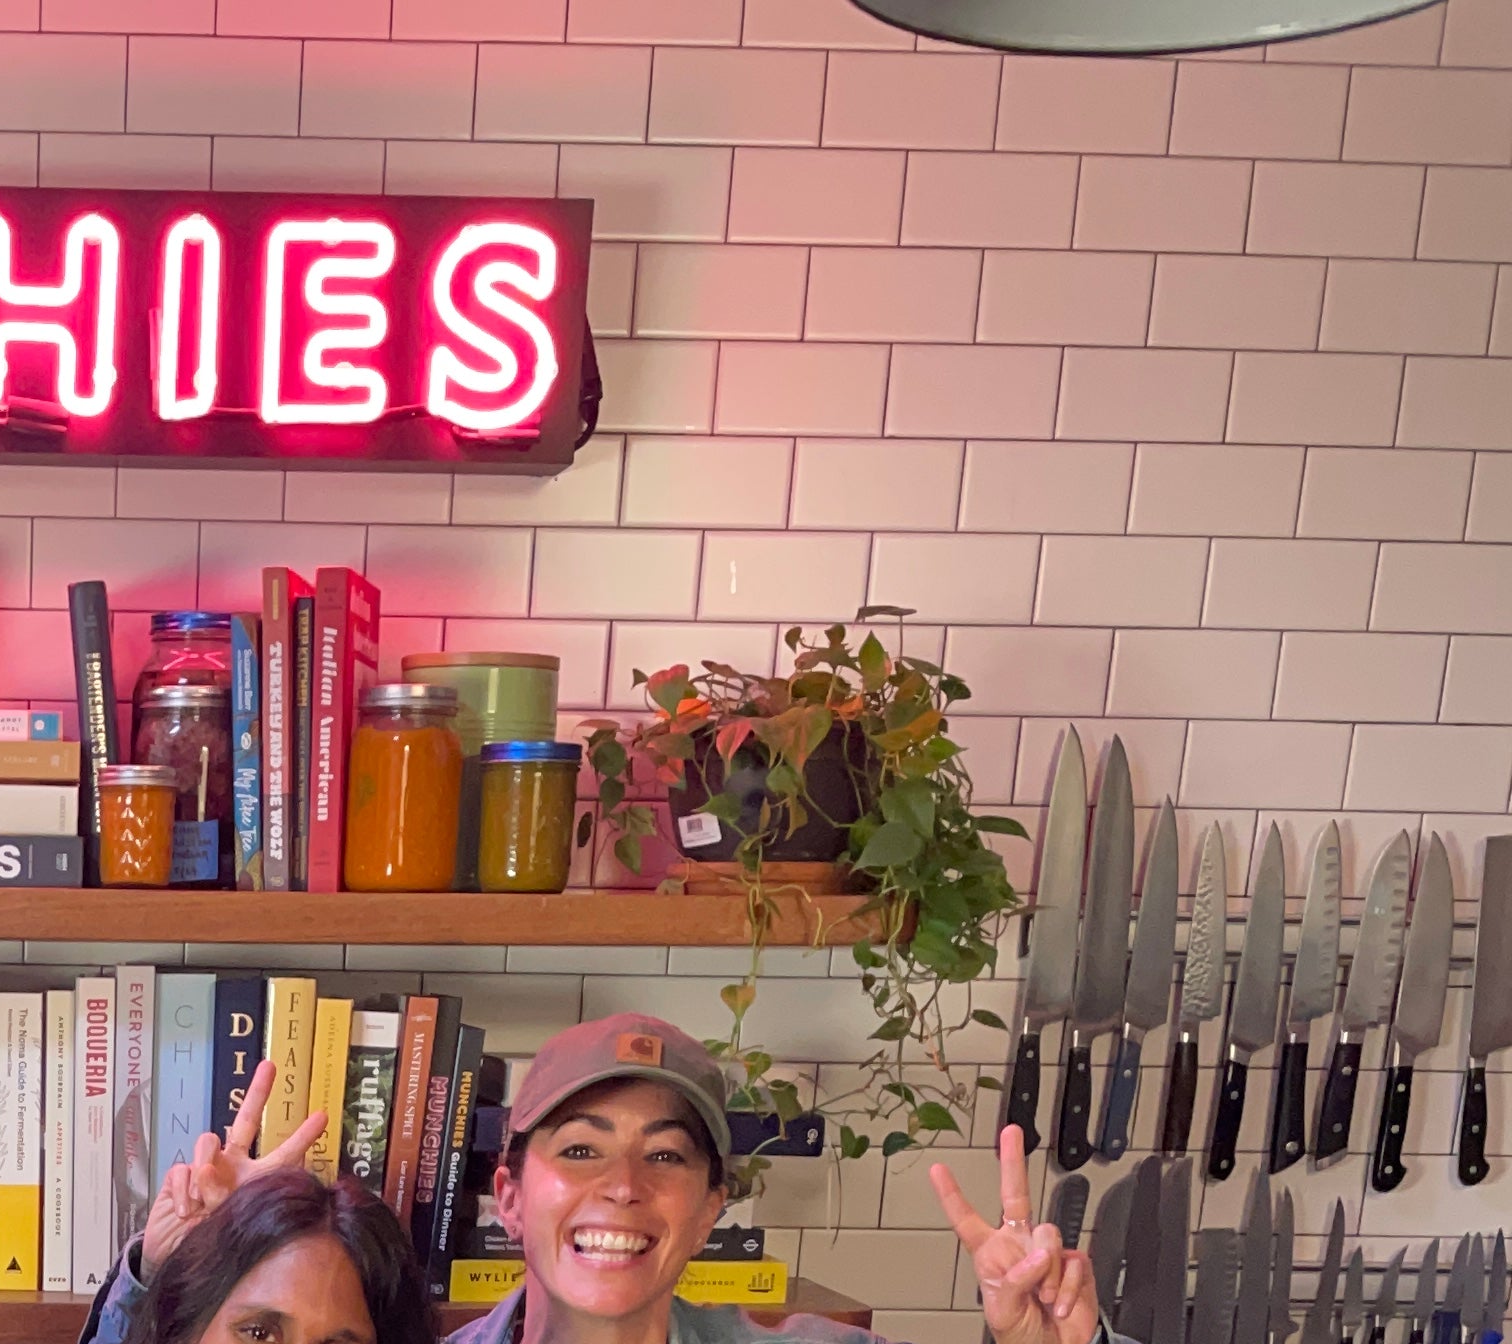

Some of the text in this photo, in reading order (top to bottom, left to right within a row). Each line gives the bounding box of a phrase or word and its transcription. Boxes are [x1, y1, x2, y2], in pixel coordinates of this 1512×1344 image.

[86, 662, 107, 754] BARTENDER'S
[320, 627, 338, 705] Italian
[234, 767, 257, 789] My
[268, 640, 283, 860] TURKEY AND THE WOLF
[317, 716, 334, 821] American
[240, 825, 257, 852] Tree
[57, 1016, 65, 1059] ANTHONY
[86, 998, 109, 1097] BOQUERIA
[127, 982, 144, 1088] EVERYONE
[171, 1003, 195, 1167] CHINA
[282, 991, 302, 1122] FEAST
[405, 1031, 425, 1104] MASTERING
[16, 1008, 28, 1171] The Noma Guide to Fermentation
[346, 1060, 386, 1179] ruffage
[402, 1105, 417, 1139] SPICE
[416, 1075, 449, 1203] MUNCHIES
[438, 1070, 474, 1251] MUNCHIES Guide to Dinner
[469, 1272, 518, 1283] WYLIE
